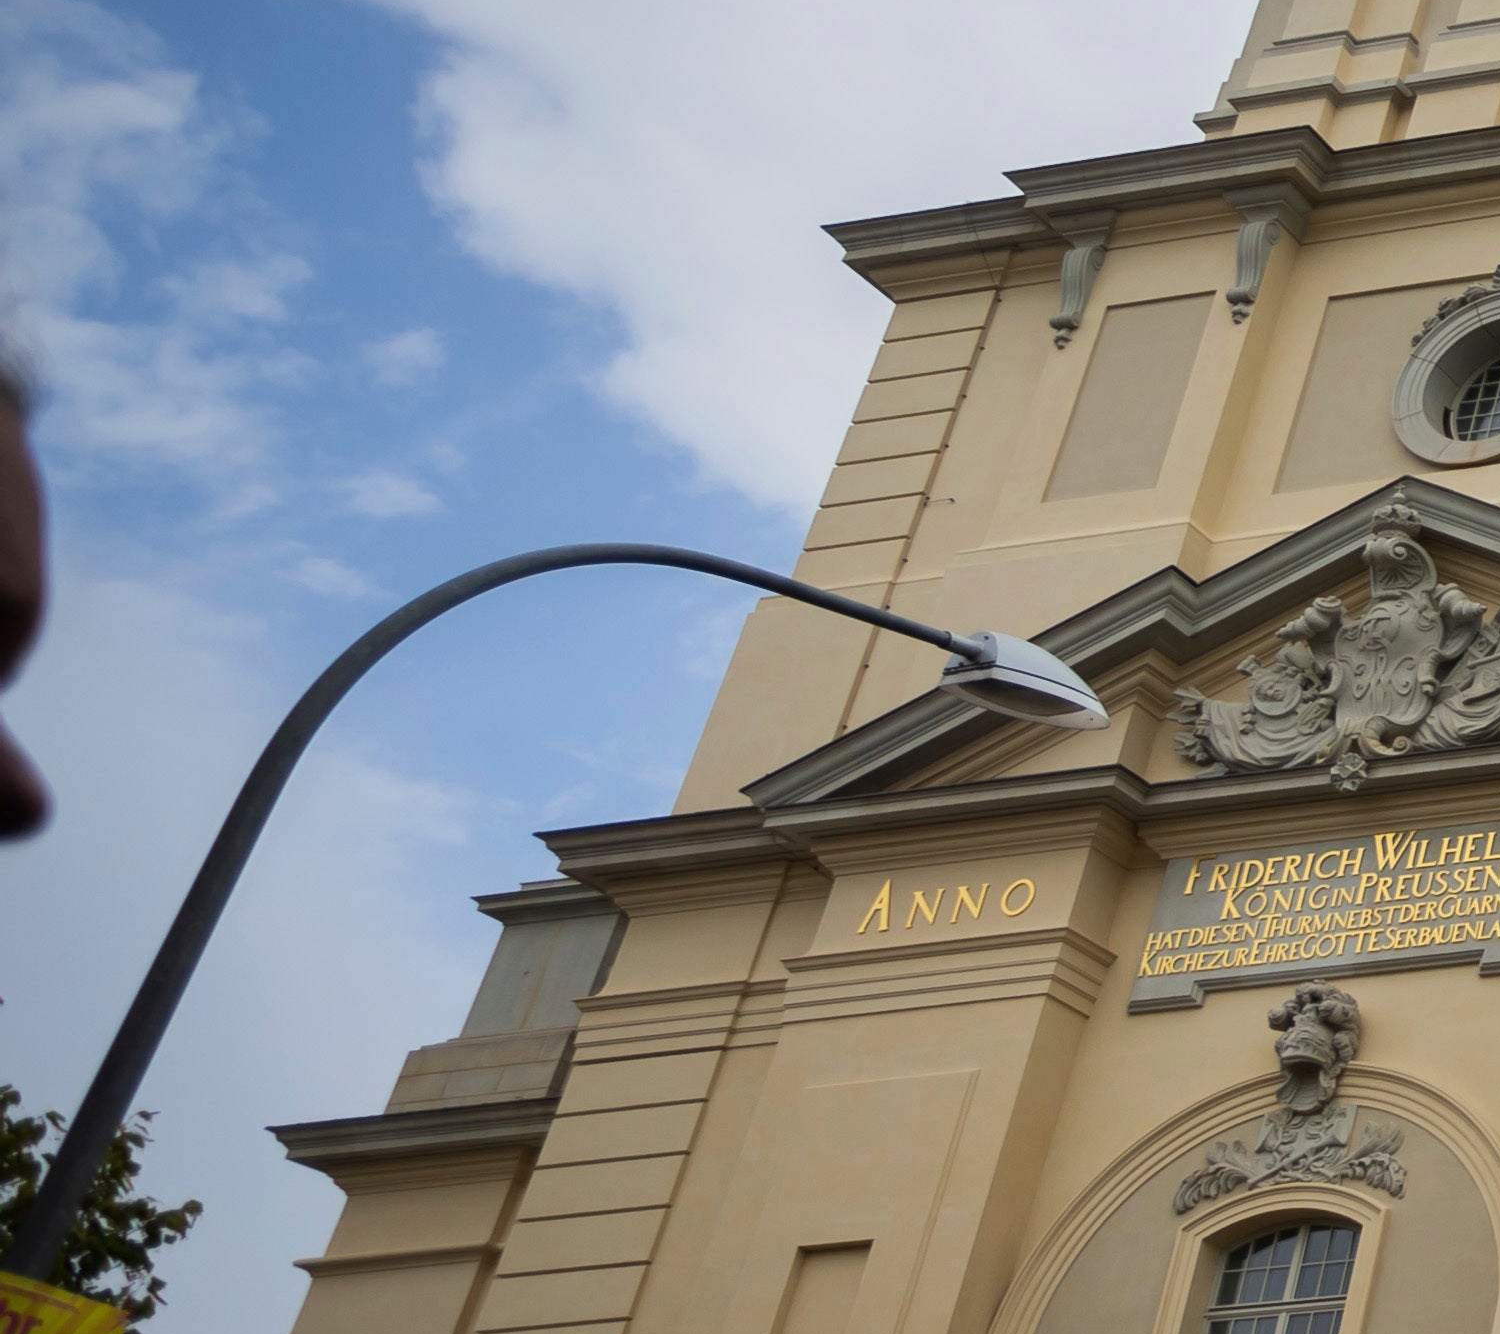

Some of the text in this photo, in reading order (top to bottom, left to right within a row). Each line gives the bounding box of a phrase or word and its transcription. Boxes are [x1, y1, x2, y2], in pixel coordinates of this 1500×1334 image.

[1183, 847, 1366, 896] FRIDERICH
[857, 877, 1036, 935] ANNO
[1220, 884, 1330, 921] KÖNIG
[1330, 886, 1357, 908] IN
